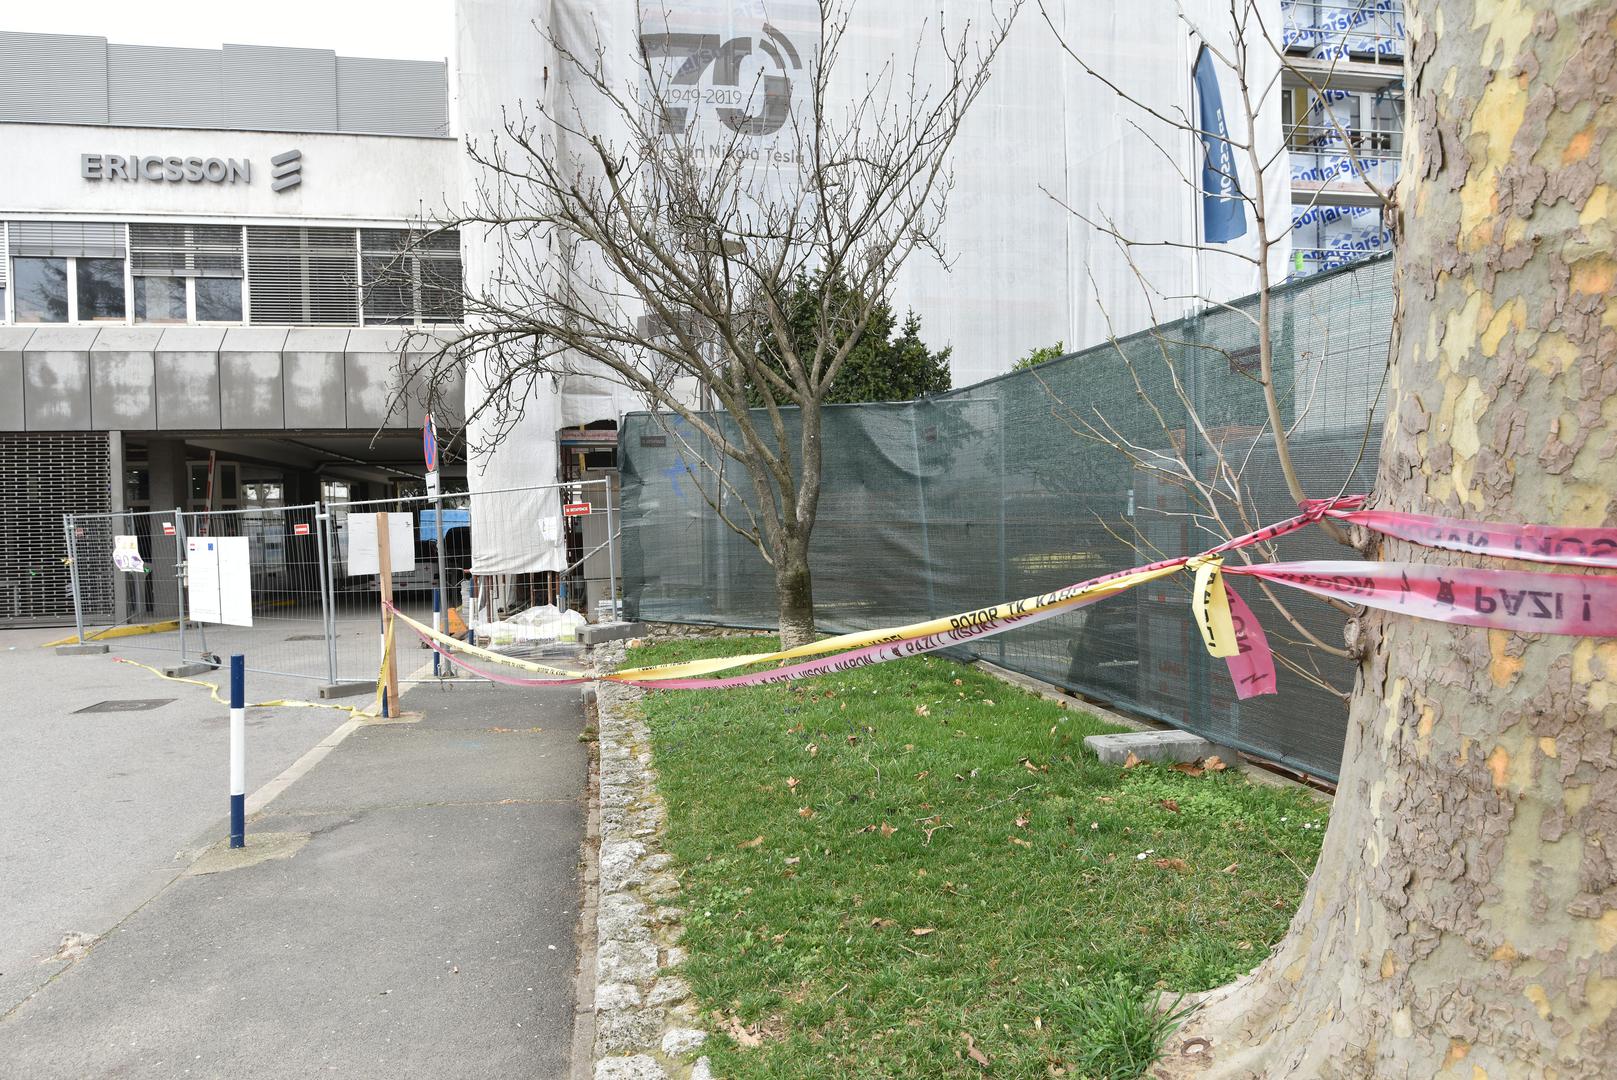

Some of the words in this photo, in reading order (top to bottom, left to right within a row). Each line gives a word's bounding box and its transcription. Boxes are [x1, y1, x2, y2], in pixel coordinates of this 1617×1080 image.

[664, 88, 742, 105] 1949-2019
[764, 148, 804, 164] Tesla
[81, 153, 251, 184] ERICSSON
[951, 607, 998, 629] POZOR
[1007, 600, 1026, 615] TK
